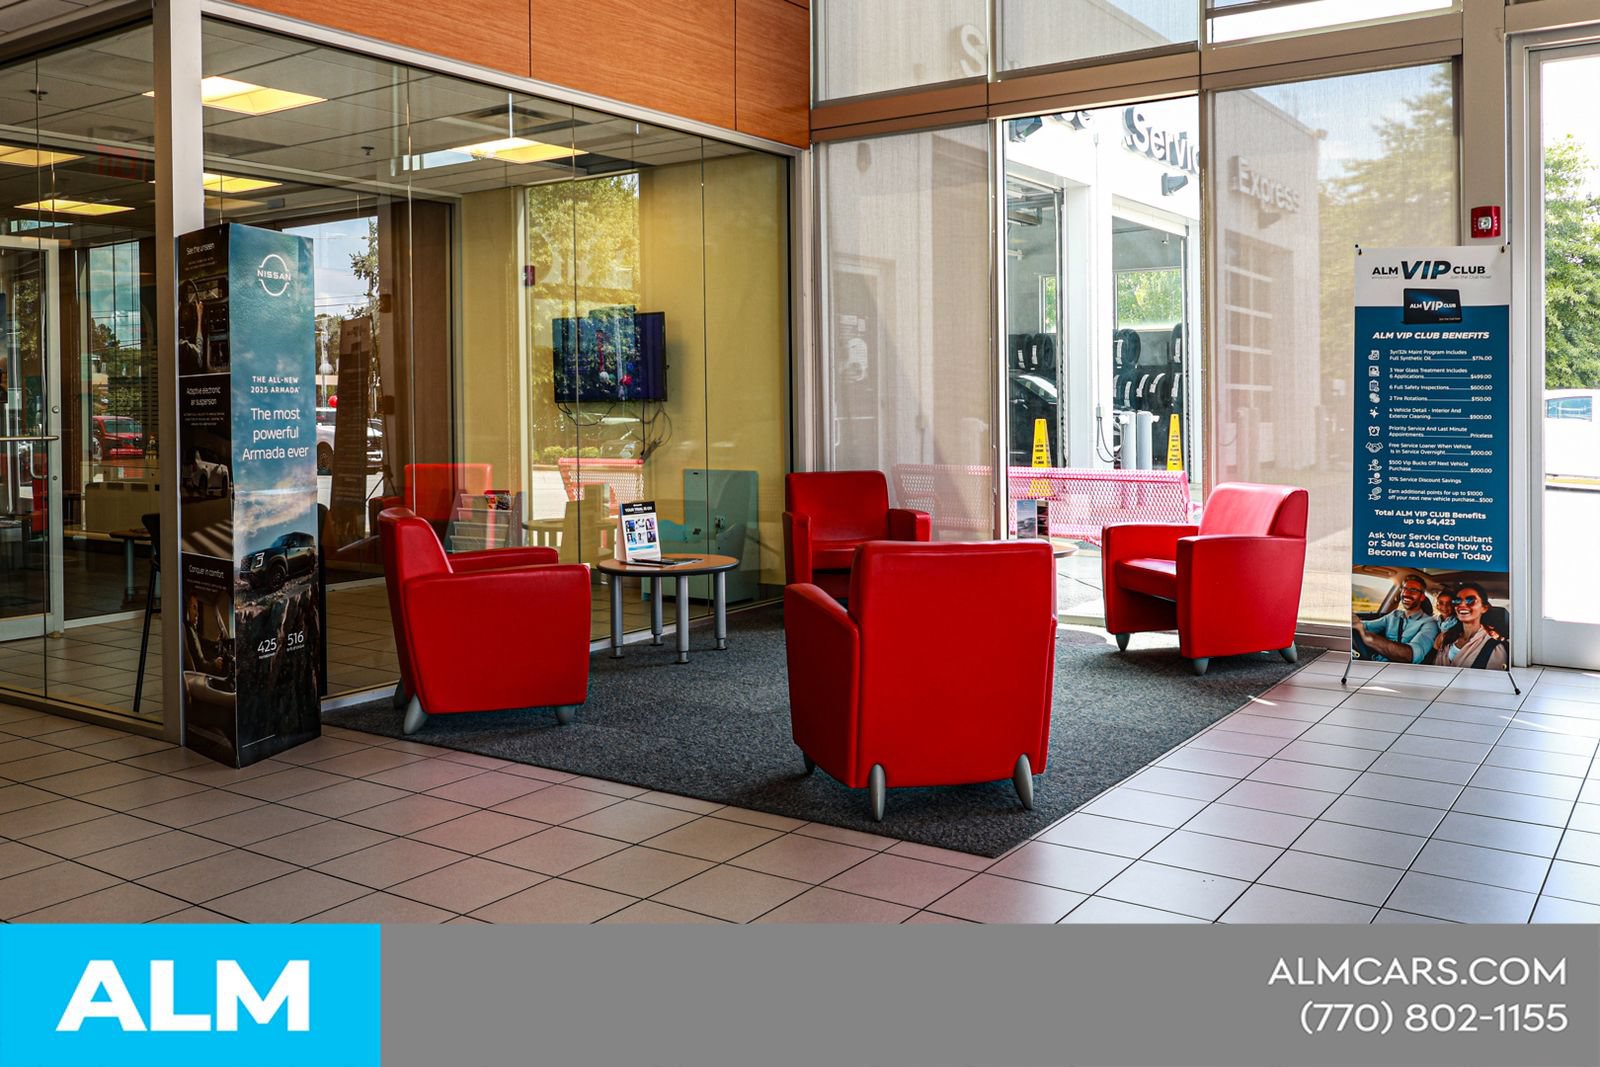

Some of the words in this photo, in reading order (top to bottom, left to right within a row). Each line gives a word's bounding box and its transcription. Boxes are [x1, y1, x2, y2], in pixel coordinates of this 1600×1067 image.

[1234, 156, 1300, 213] Express
[257, 270, 291, 281] NISSAN
[1372, 267, 1398, 275] ALM
[1401, 260, 1451, 280] VIP
[1453, 265, 1486, 275] CLUB
[1423, 301, 1444, 311] VIP
[1442, 331, 1490, 339] BENEFITS
[268, 376, 299, 384] ALL-NEW
[250, 408, 271, 420] The
[273, 407, 301, 420] most
[253, 426, 299, 443] powerful
[242, 446, 285, 461] Armada
[287, 447, 309, 458] ever
[1426, 518, 1456, 526] $4,423
[1387, 532, 1406, 540] Your
[1443, 534, 1493, 543] Consultant
[1381, 540, 1405, 548] Sales
[1408, 541, 1455, 549] Associate
[1457, 543, 1478, 551] how
[1368, 548, 1407, 556] Become
[1418, 551, 1459, 559] Member
[1462, 552, 1492, 562] Today
[257, 637, 277, 653] 425
[287, 631, 304, 646] 516
